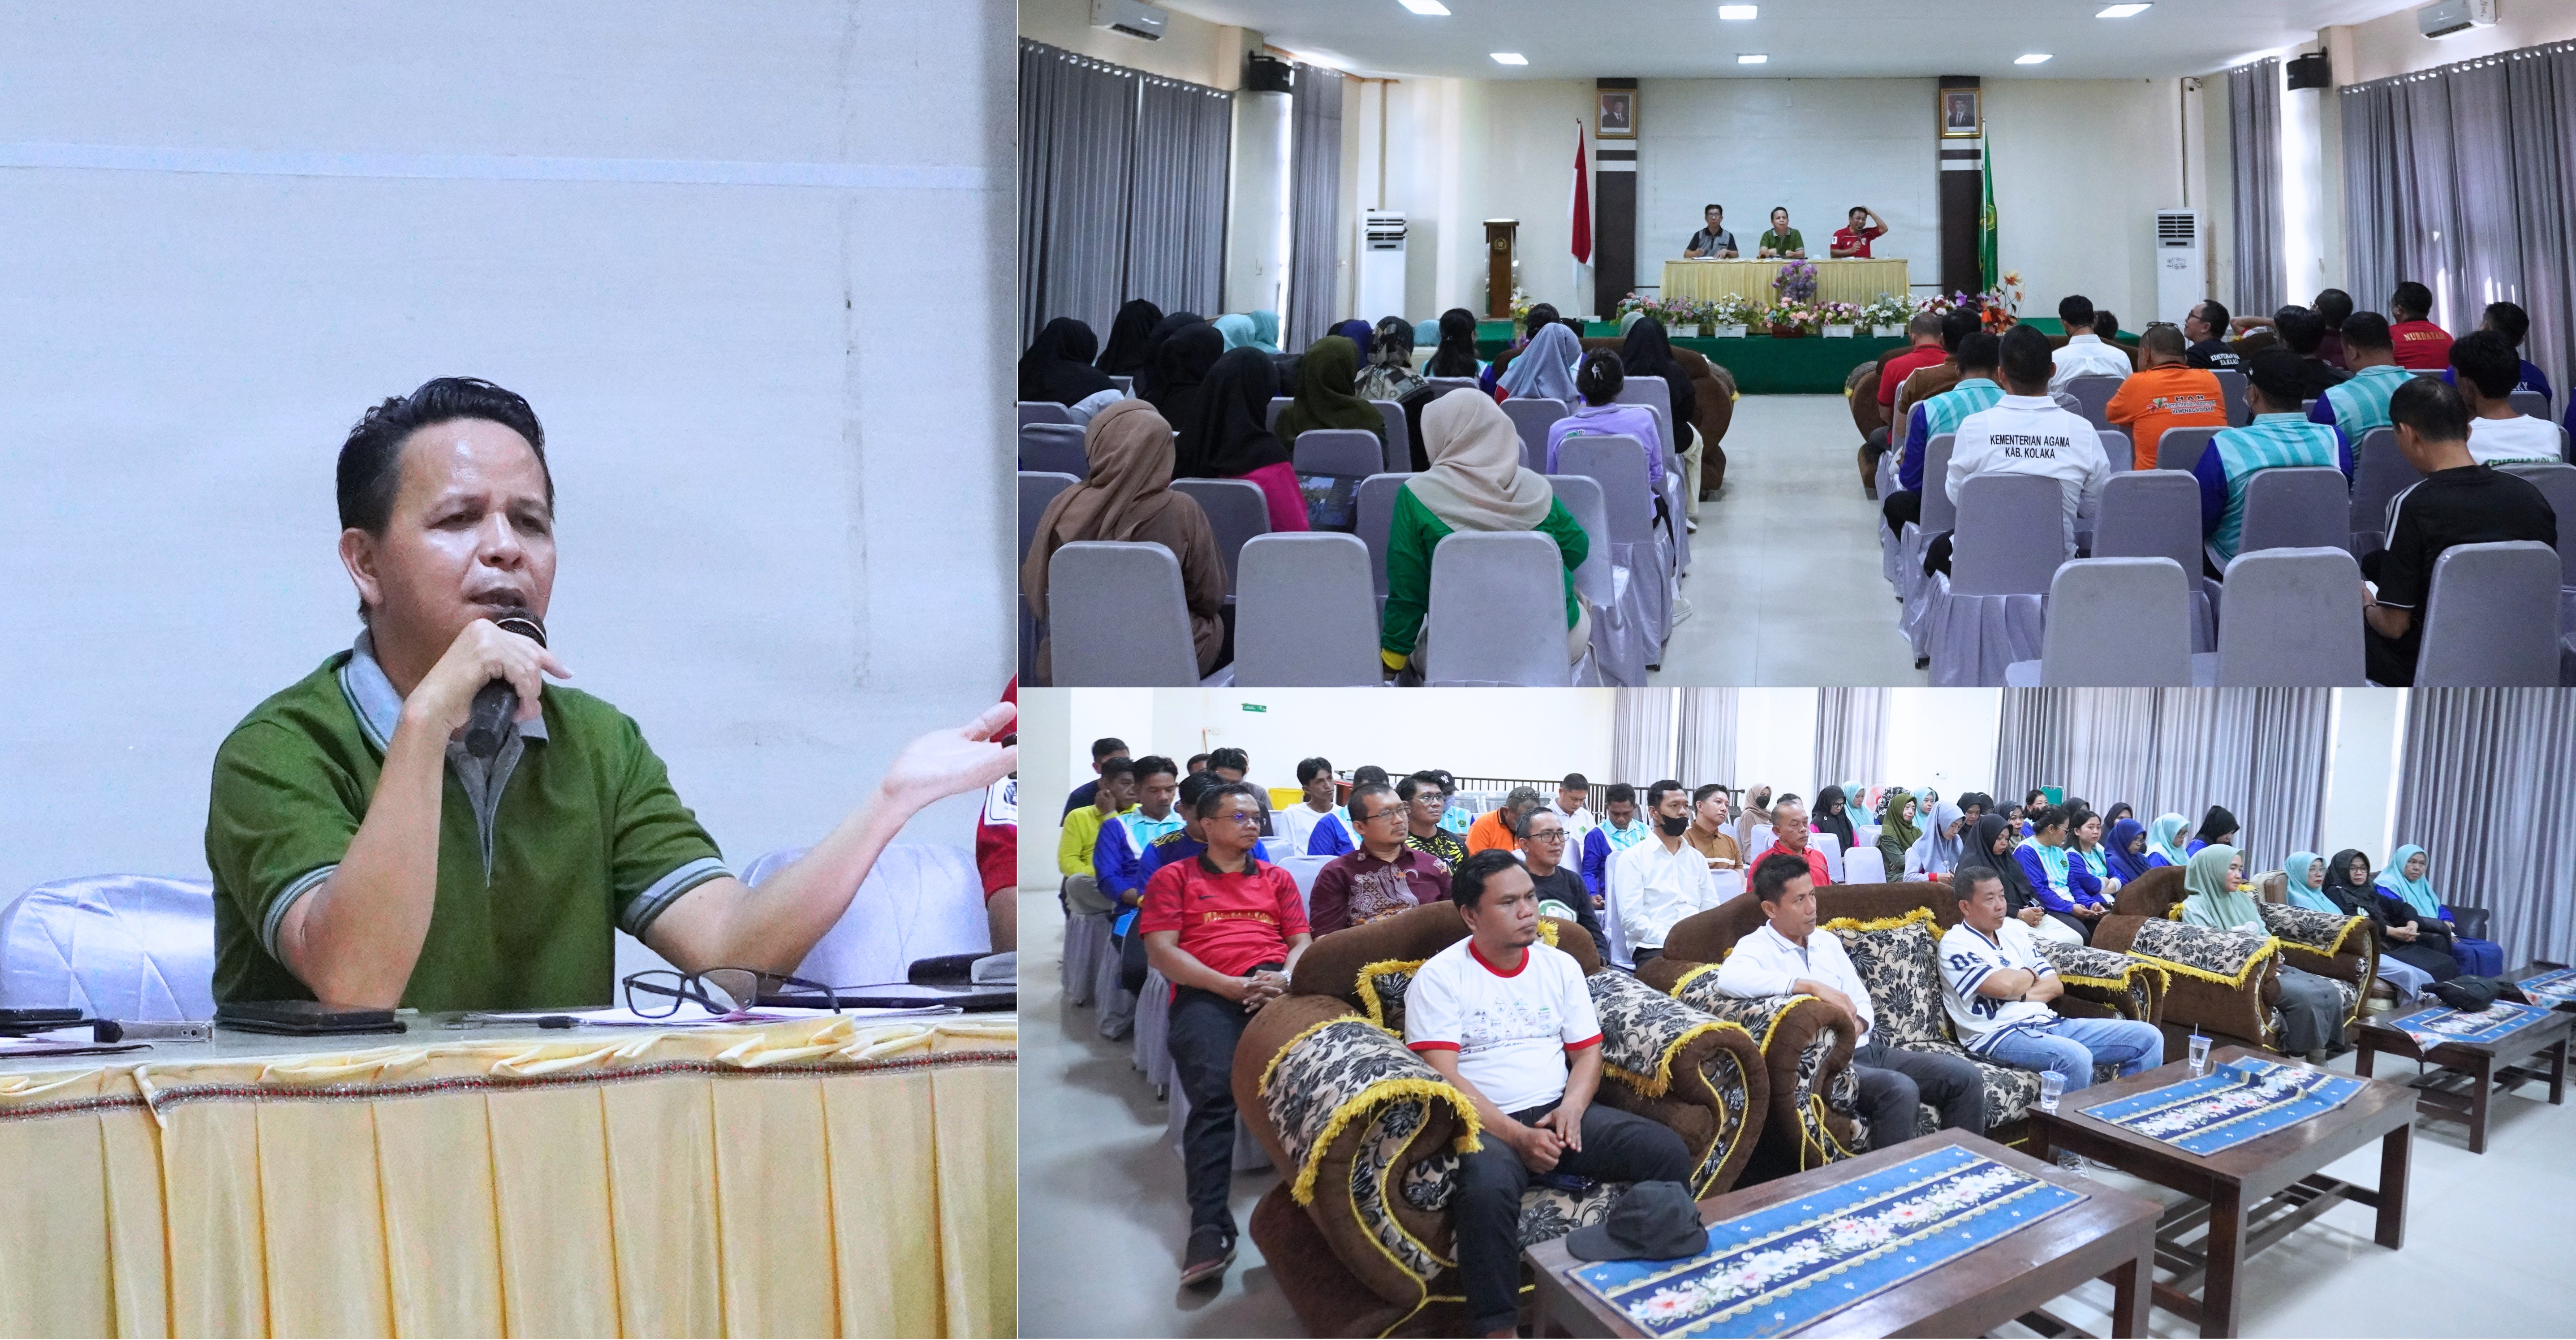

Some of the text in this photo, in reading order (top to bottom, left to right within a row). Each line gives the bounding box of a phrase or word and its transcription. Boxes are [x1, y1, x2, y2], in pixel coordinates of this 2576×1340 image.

[1990, 434, 2070, 448] KEMENTERIAN AGAMA
[2005, 447, 2055, 459] KAB. KOLAKA
